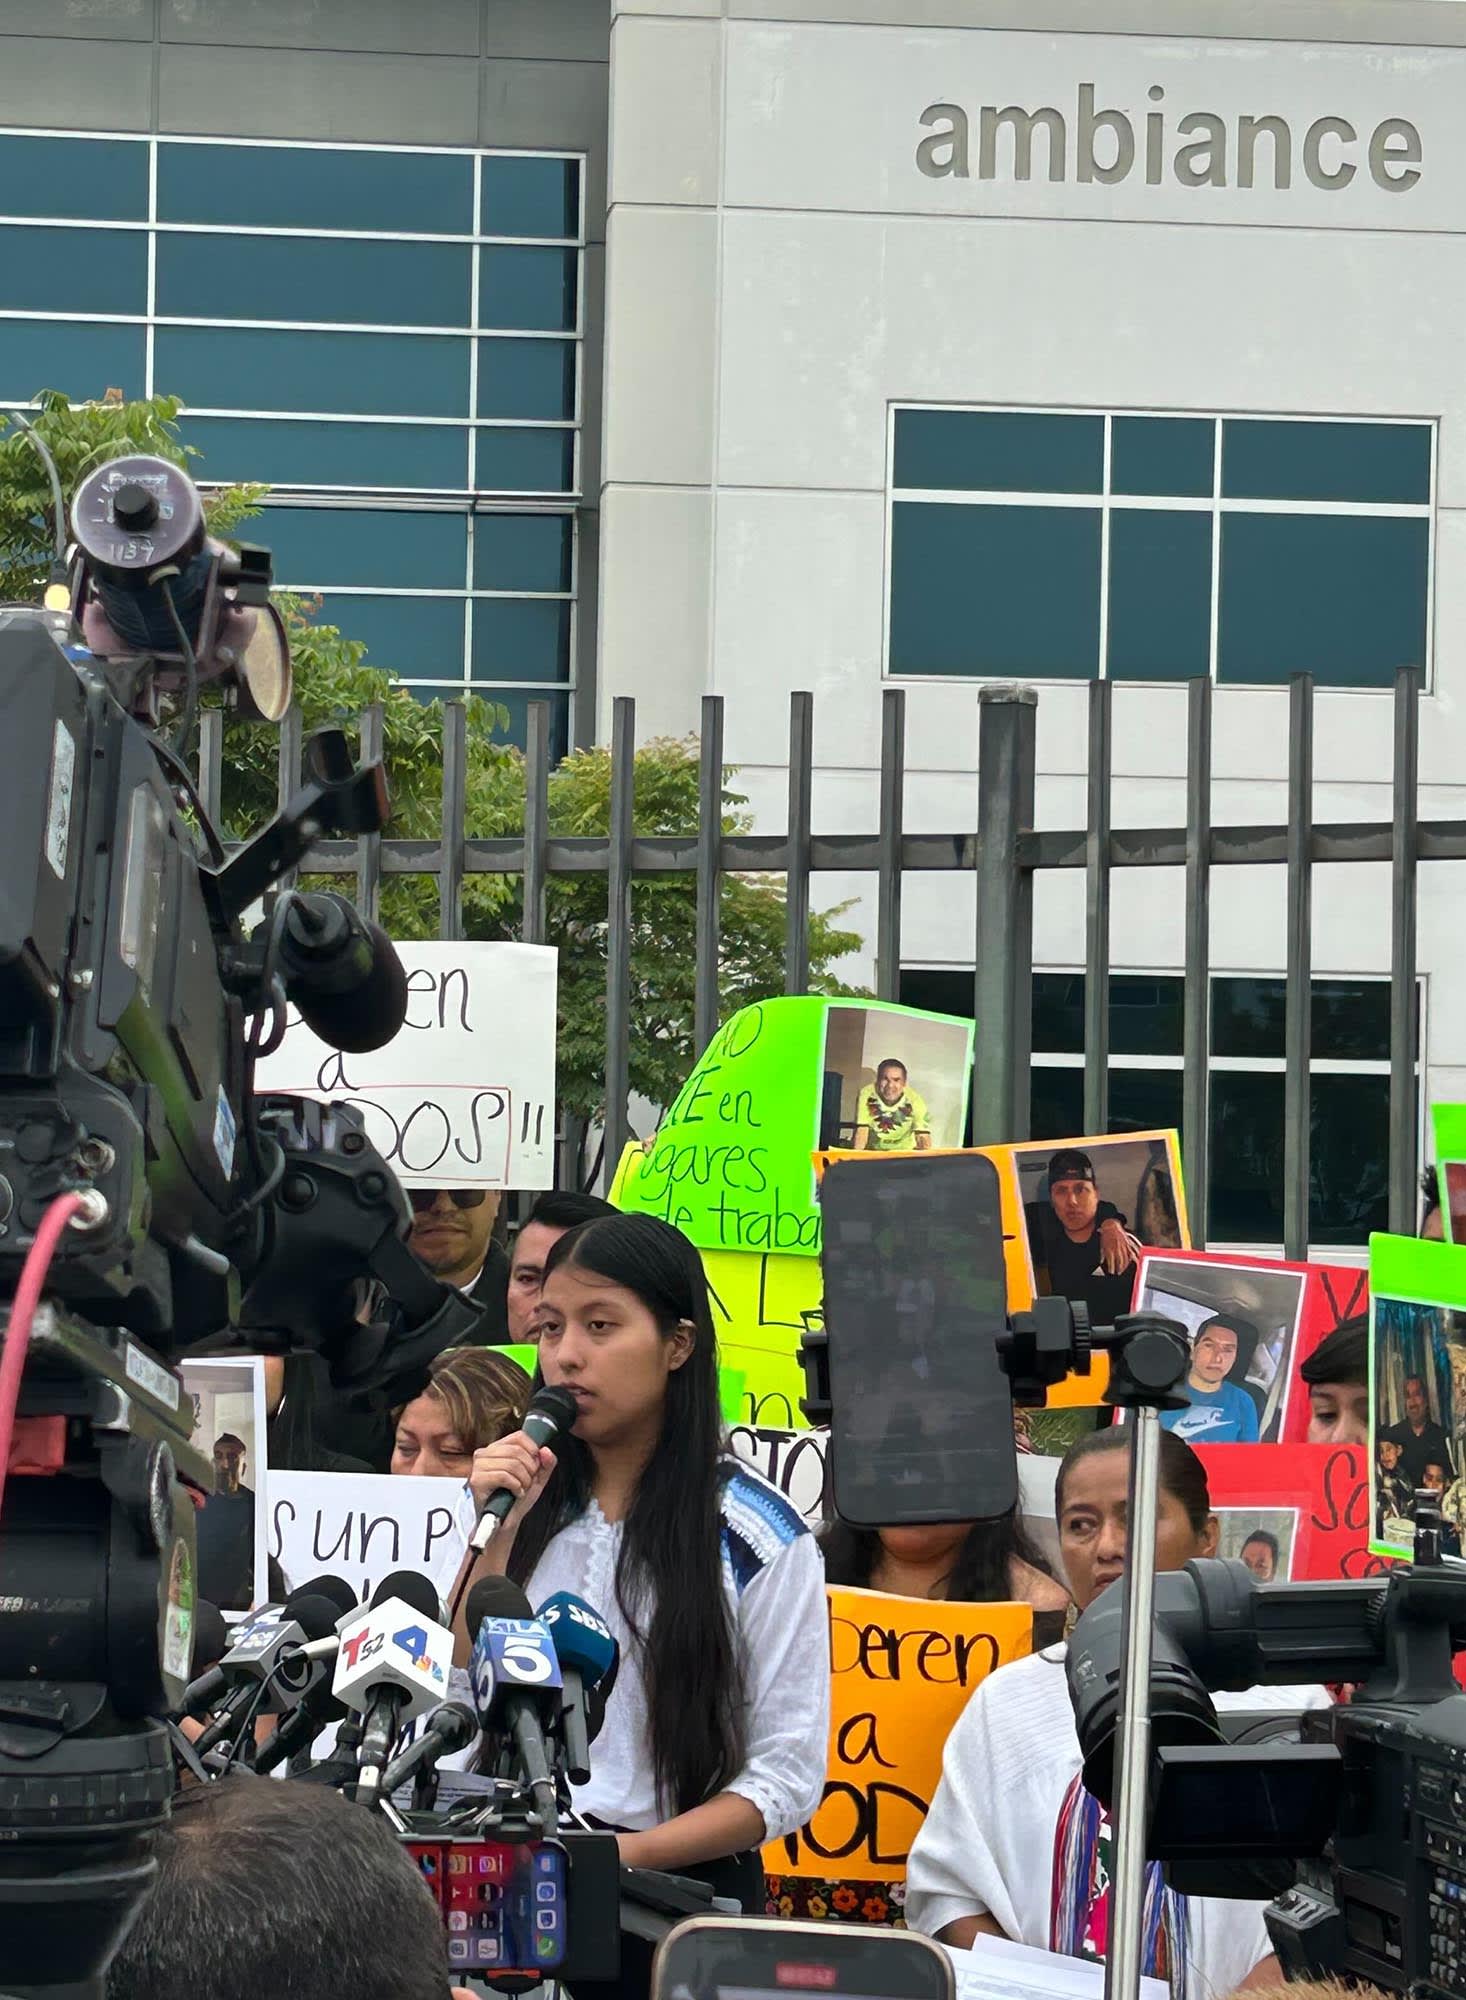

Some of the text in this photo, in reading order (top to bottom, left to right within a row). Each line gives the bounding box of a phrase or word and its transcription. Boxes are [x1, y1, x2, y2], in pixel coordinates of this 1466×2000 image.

[915, 82, 1424, 193] ambiance
[317, 1051, 361, 1092] a
[719, 1090, 762, 1127] en
[640, 1144, 769, 1201] ugares
[707, 1187, 820, 1249] traba
[501, 1636, 552, 1683] 5
[837, 1712, 899, 1768] a
